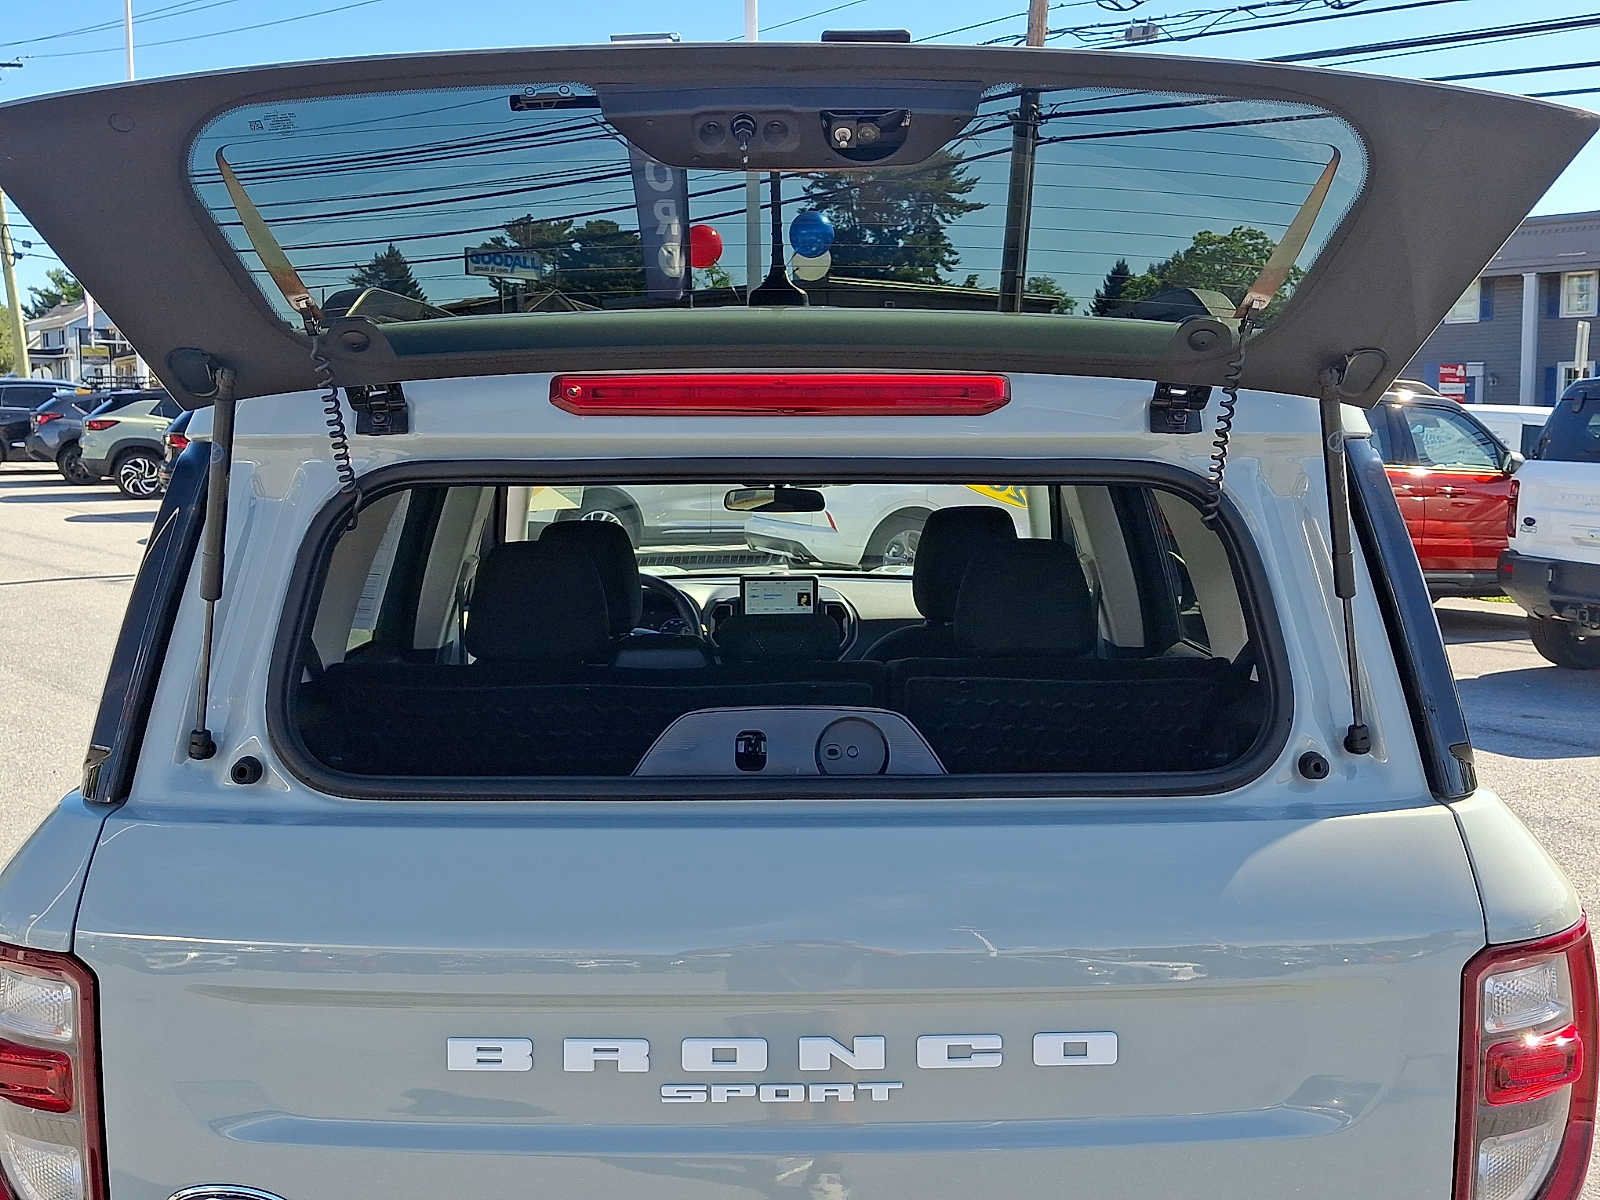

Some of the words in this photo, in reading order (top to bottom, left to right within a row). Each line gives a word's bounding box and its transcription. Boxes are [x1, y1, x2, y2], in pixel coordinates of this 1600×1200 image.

[470, 252, 541, 271] GOODALL
[446, 1031, 1119, 1072] BRONCO
[660, 1081, 904, 1104] SPORT
